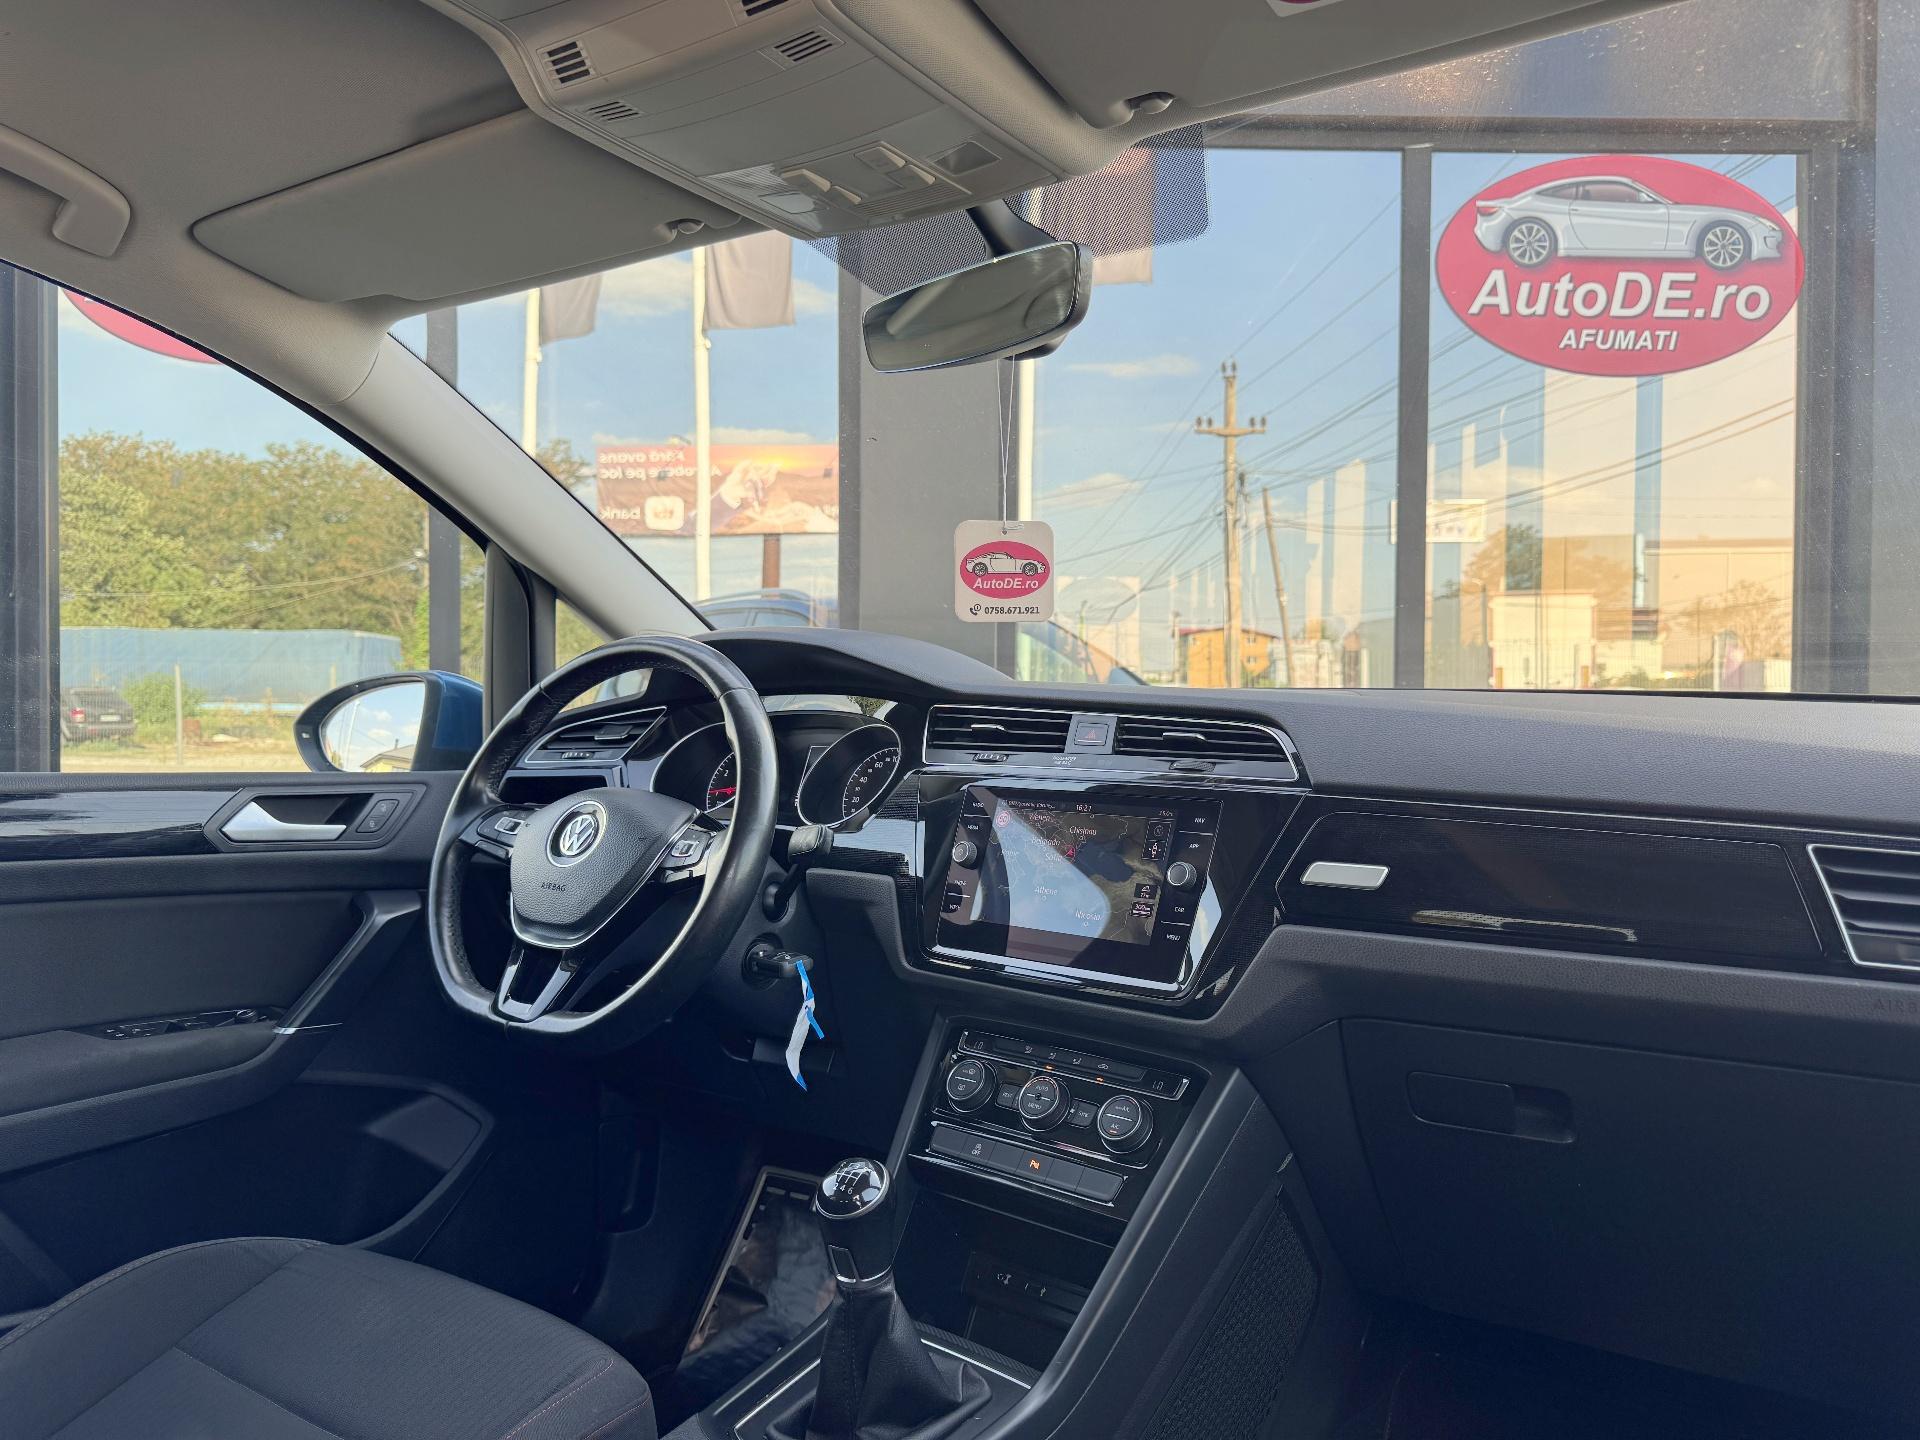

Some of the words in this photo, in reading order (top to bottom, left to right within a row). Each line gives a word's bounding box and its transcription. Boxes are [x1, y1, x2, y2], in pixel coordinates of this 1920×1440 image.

[1468, 269, 1771, 320] AutoDE.ro
[1558, 329, 1678, 351] AFUMATI
[973, 577, 1039, 589] AutoDE.ro
[984, 606, 1040, 615] 0758.671.921
